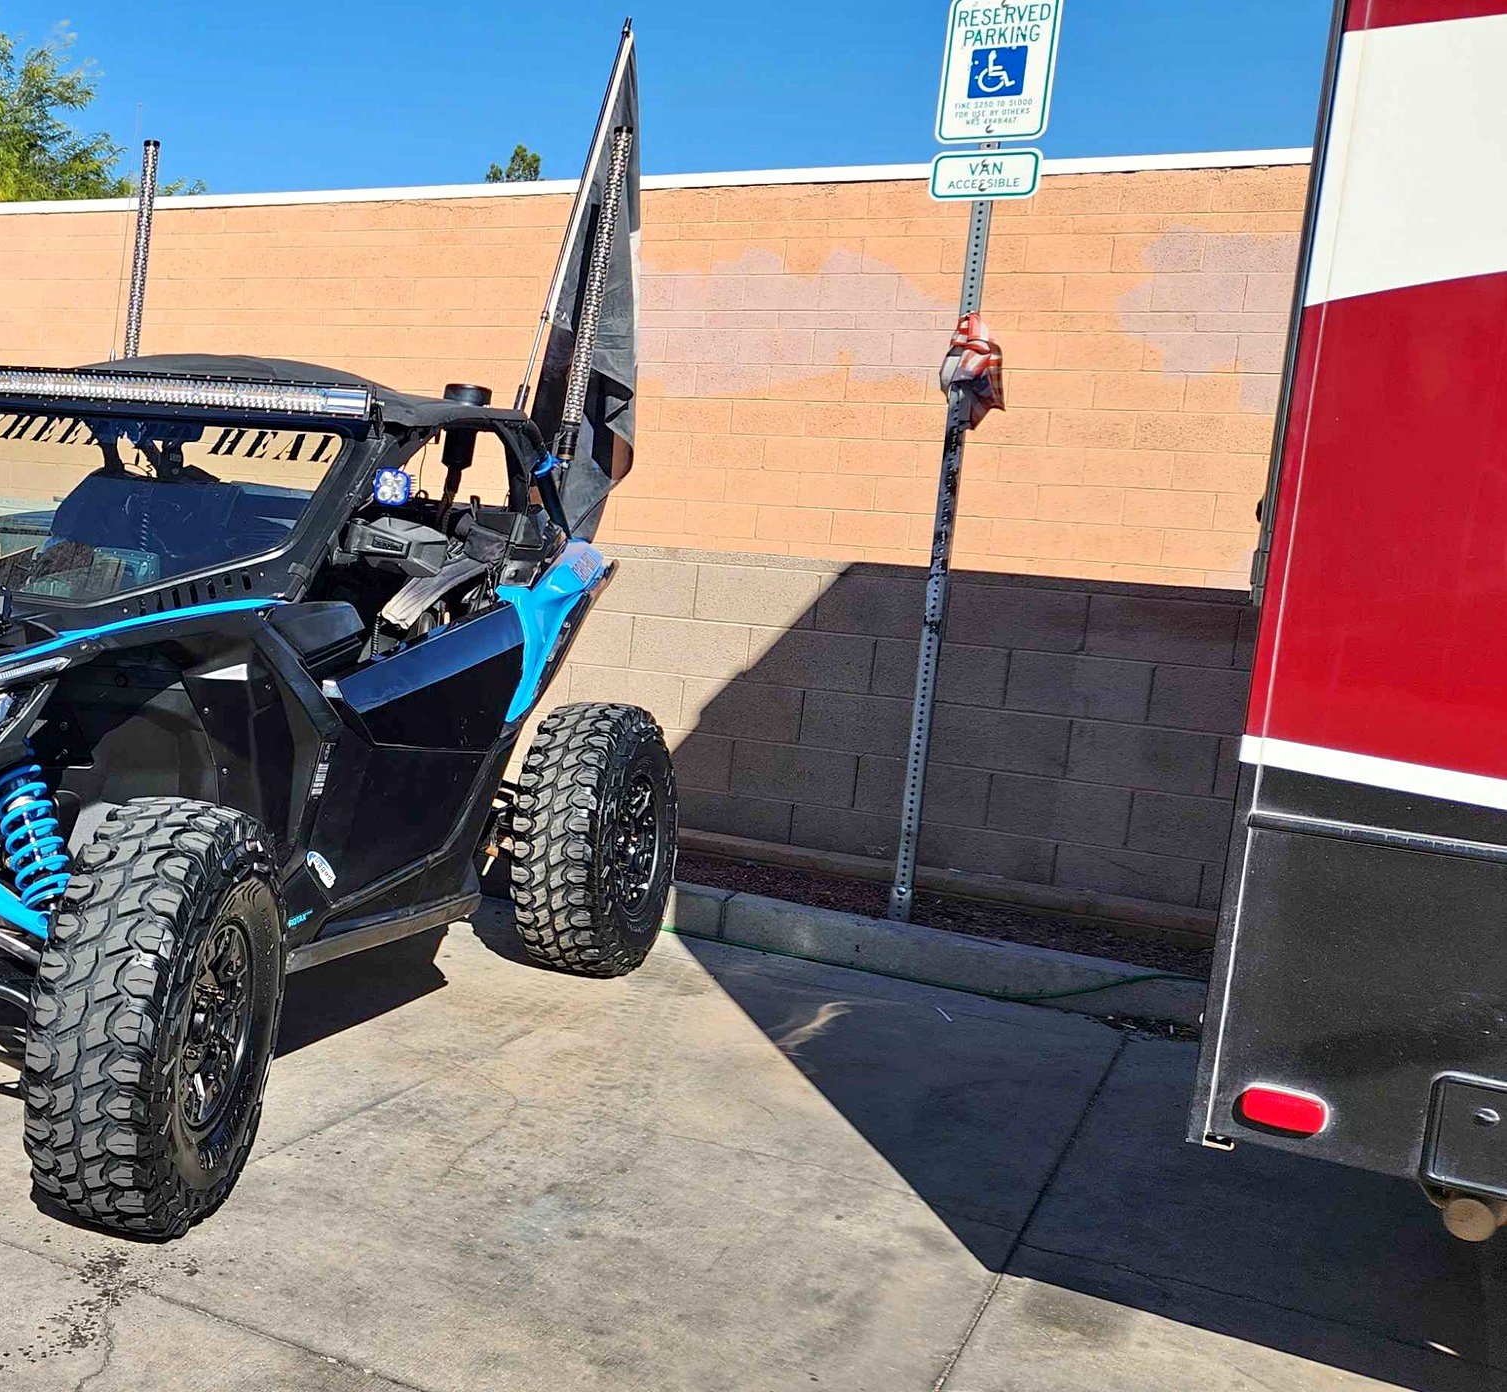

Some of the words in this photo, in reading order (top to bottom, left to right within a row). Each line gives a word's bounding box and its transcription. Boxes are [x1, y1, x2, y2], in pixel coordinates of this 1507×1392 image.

[957, 3, 1051, 28] RESERVED
[963, 24, 1041, 47] PARKING
[969, 161, 1003, 176] VAN
[206, 428, 336, 464] HEAL
